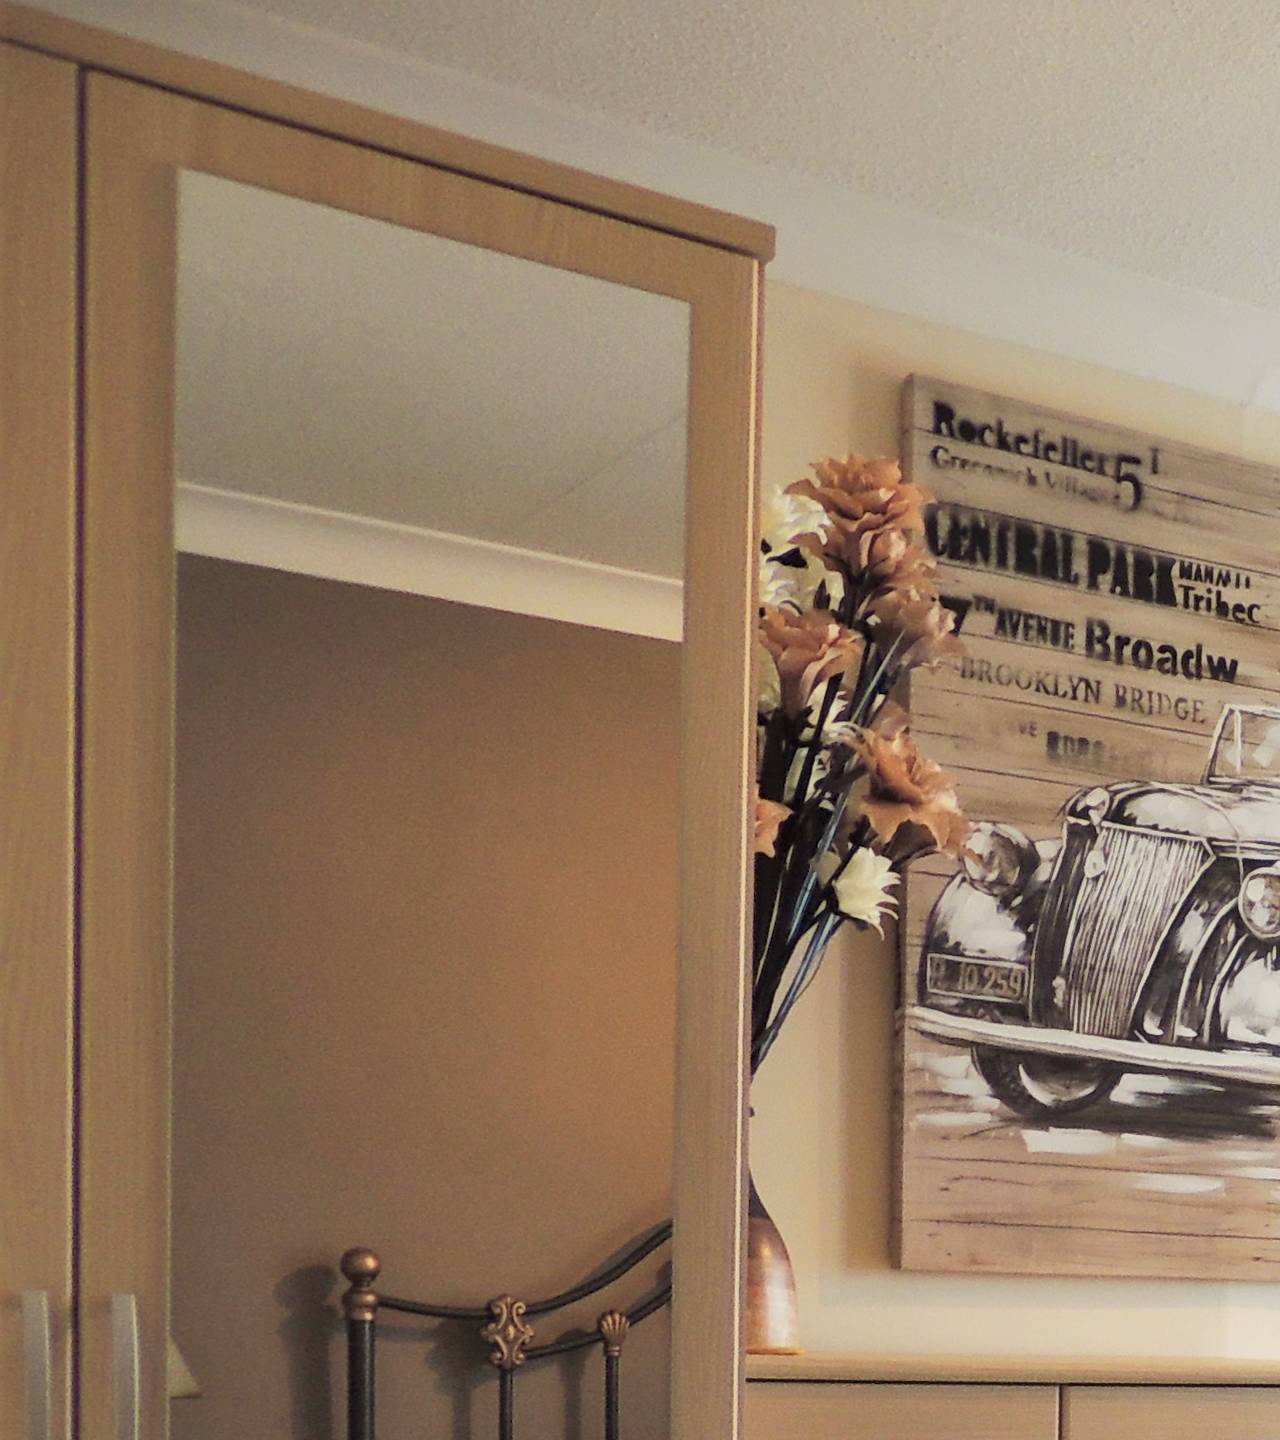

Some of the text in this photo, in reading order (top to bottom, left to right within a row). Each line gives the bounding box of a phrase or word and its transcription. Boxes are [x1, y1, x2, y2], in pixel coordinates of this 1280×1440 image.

[932, 400, 1107, 475] Rockefeller
[924, 502, 1177, 607] CENTRAL PARK
[994, 608, 1075, 650] AVENUE
[1084, 617, 1239, 682] Broadw
[960, 655, 1206, 725] BROOKLYN BRIDGE
